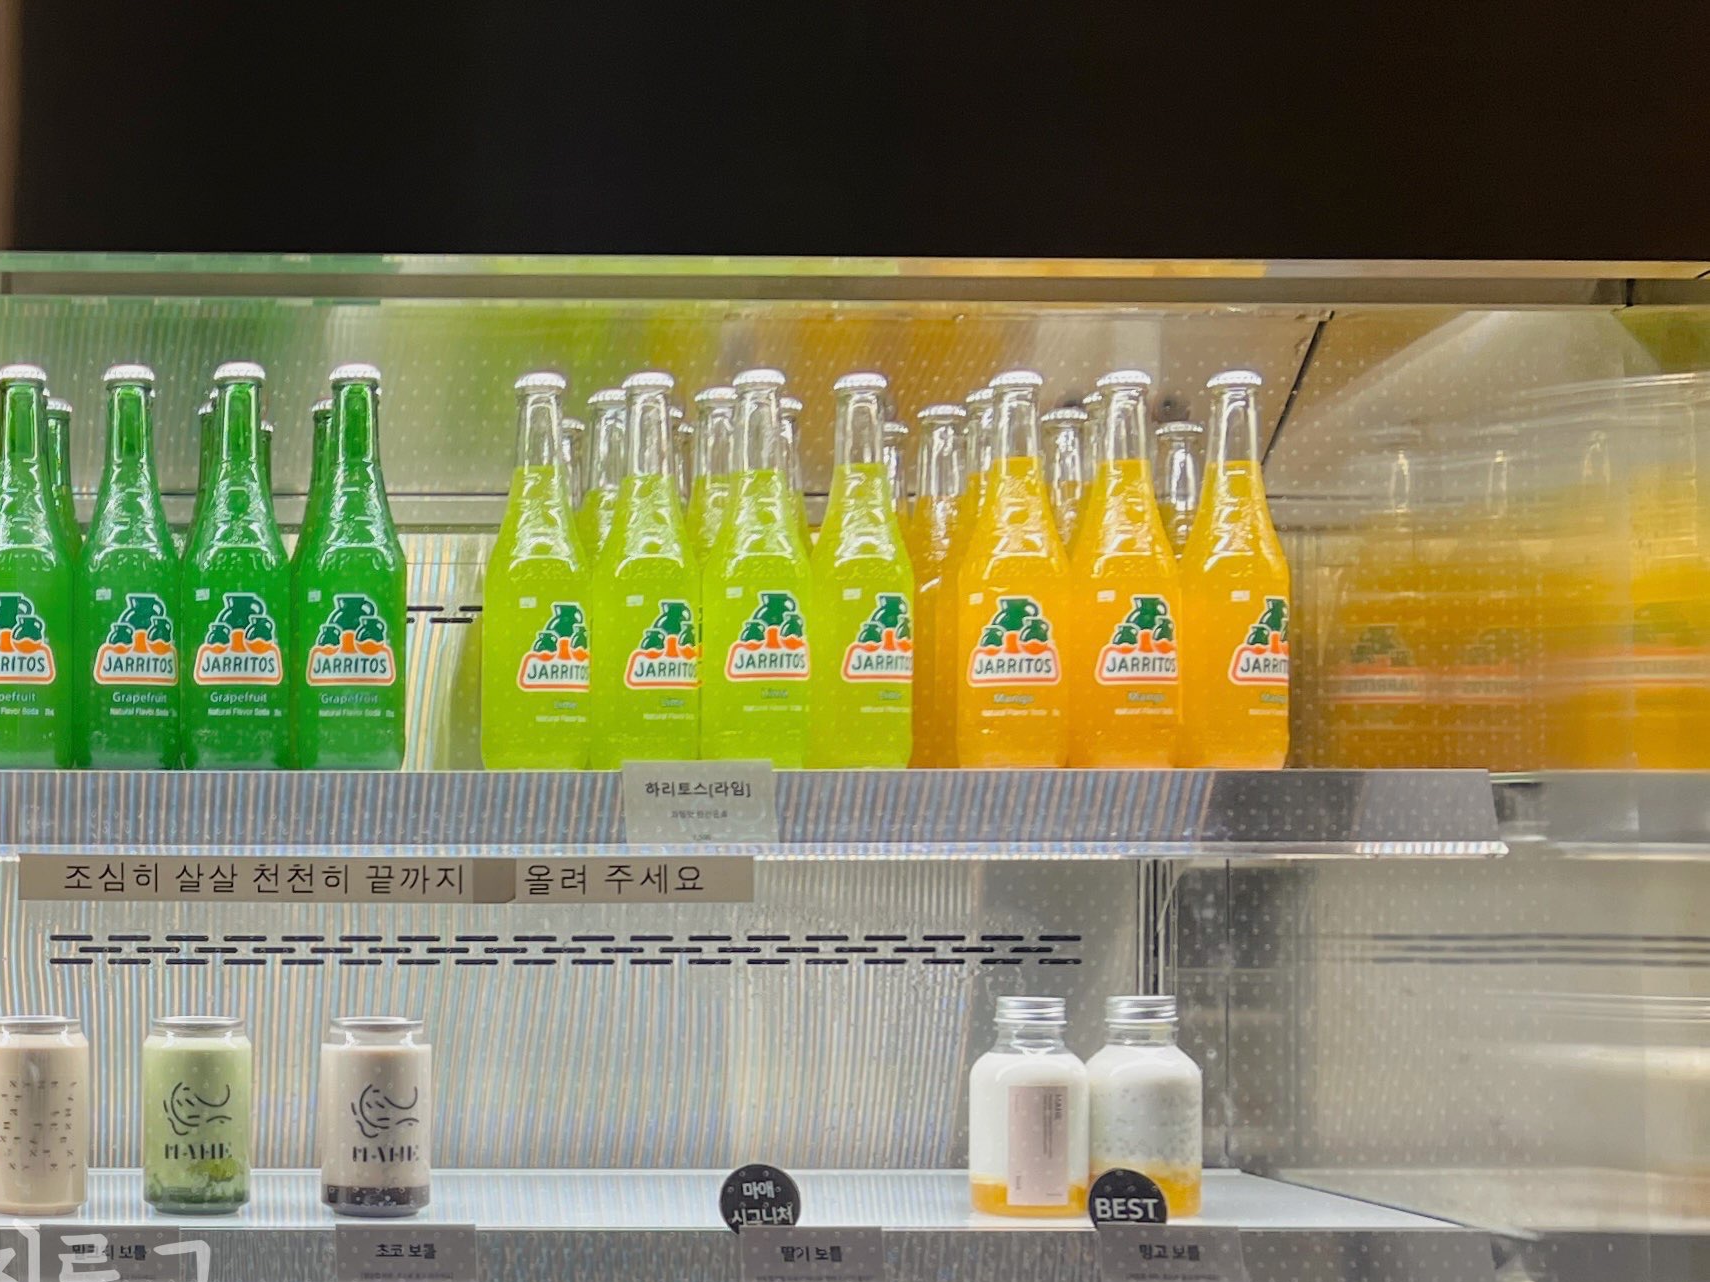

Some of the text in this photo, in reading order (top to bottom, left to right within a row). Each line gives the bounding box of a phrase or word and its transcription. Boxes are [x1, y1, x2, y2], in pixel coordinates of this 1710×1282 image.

[103, 656, 173, 674] JARRITOS
[202, 656, 275, 673] JARRITOS
[313, 657, 387, 674] JARRITOS
[735, 653, 806, 669] JARRITOS
[975, 657, 1052, 675] JARRITOS
[1107, 656, 1176, 674] JARRITOS
[1240, 656, 1289, 674] JARRIT
[645, 781, 751, 798] 하리토스[라임]
[64, 861, 705, 894] 조심히 살살 천천히 끝까지 올려 주세요
[741, 1180, 776, 1200] 마애
[731, 1204, 794, 1226] 시그니처
[1094, 1197, 1159, 1221] BEST
[375, 1243, 404, 1258] 초코
[780, 1245, 810, 1262] 딸기
